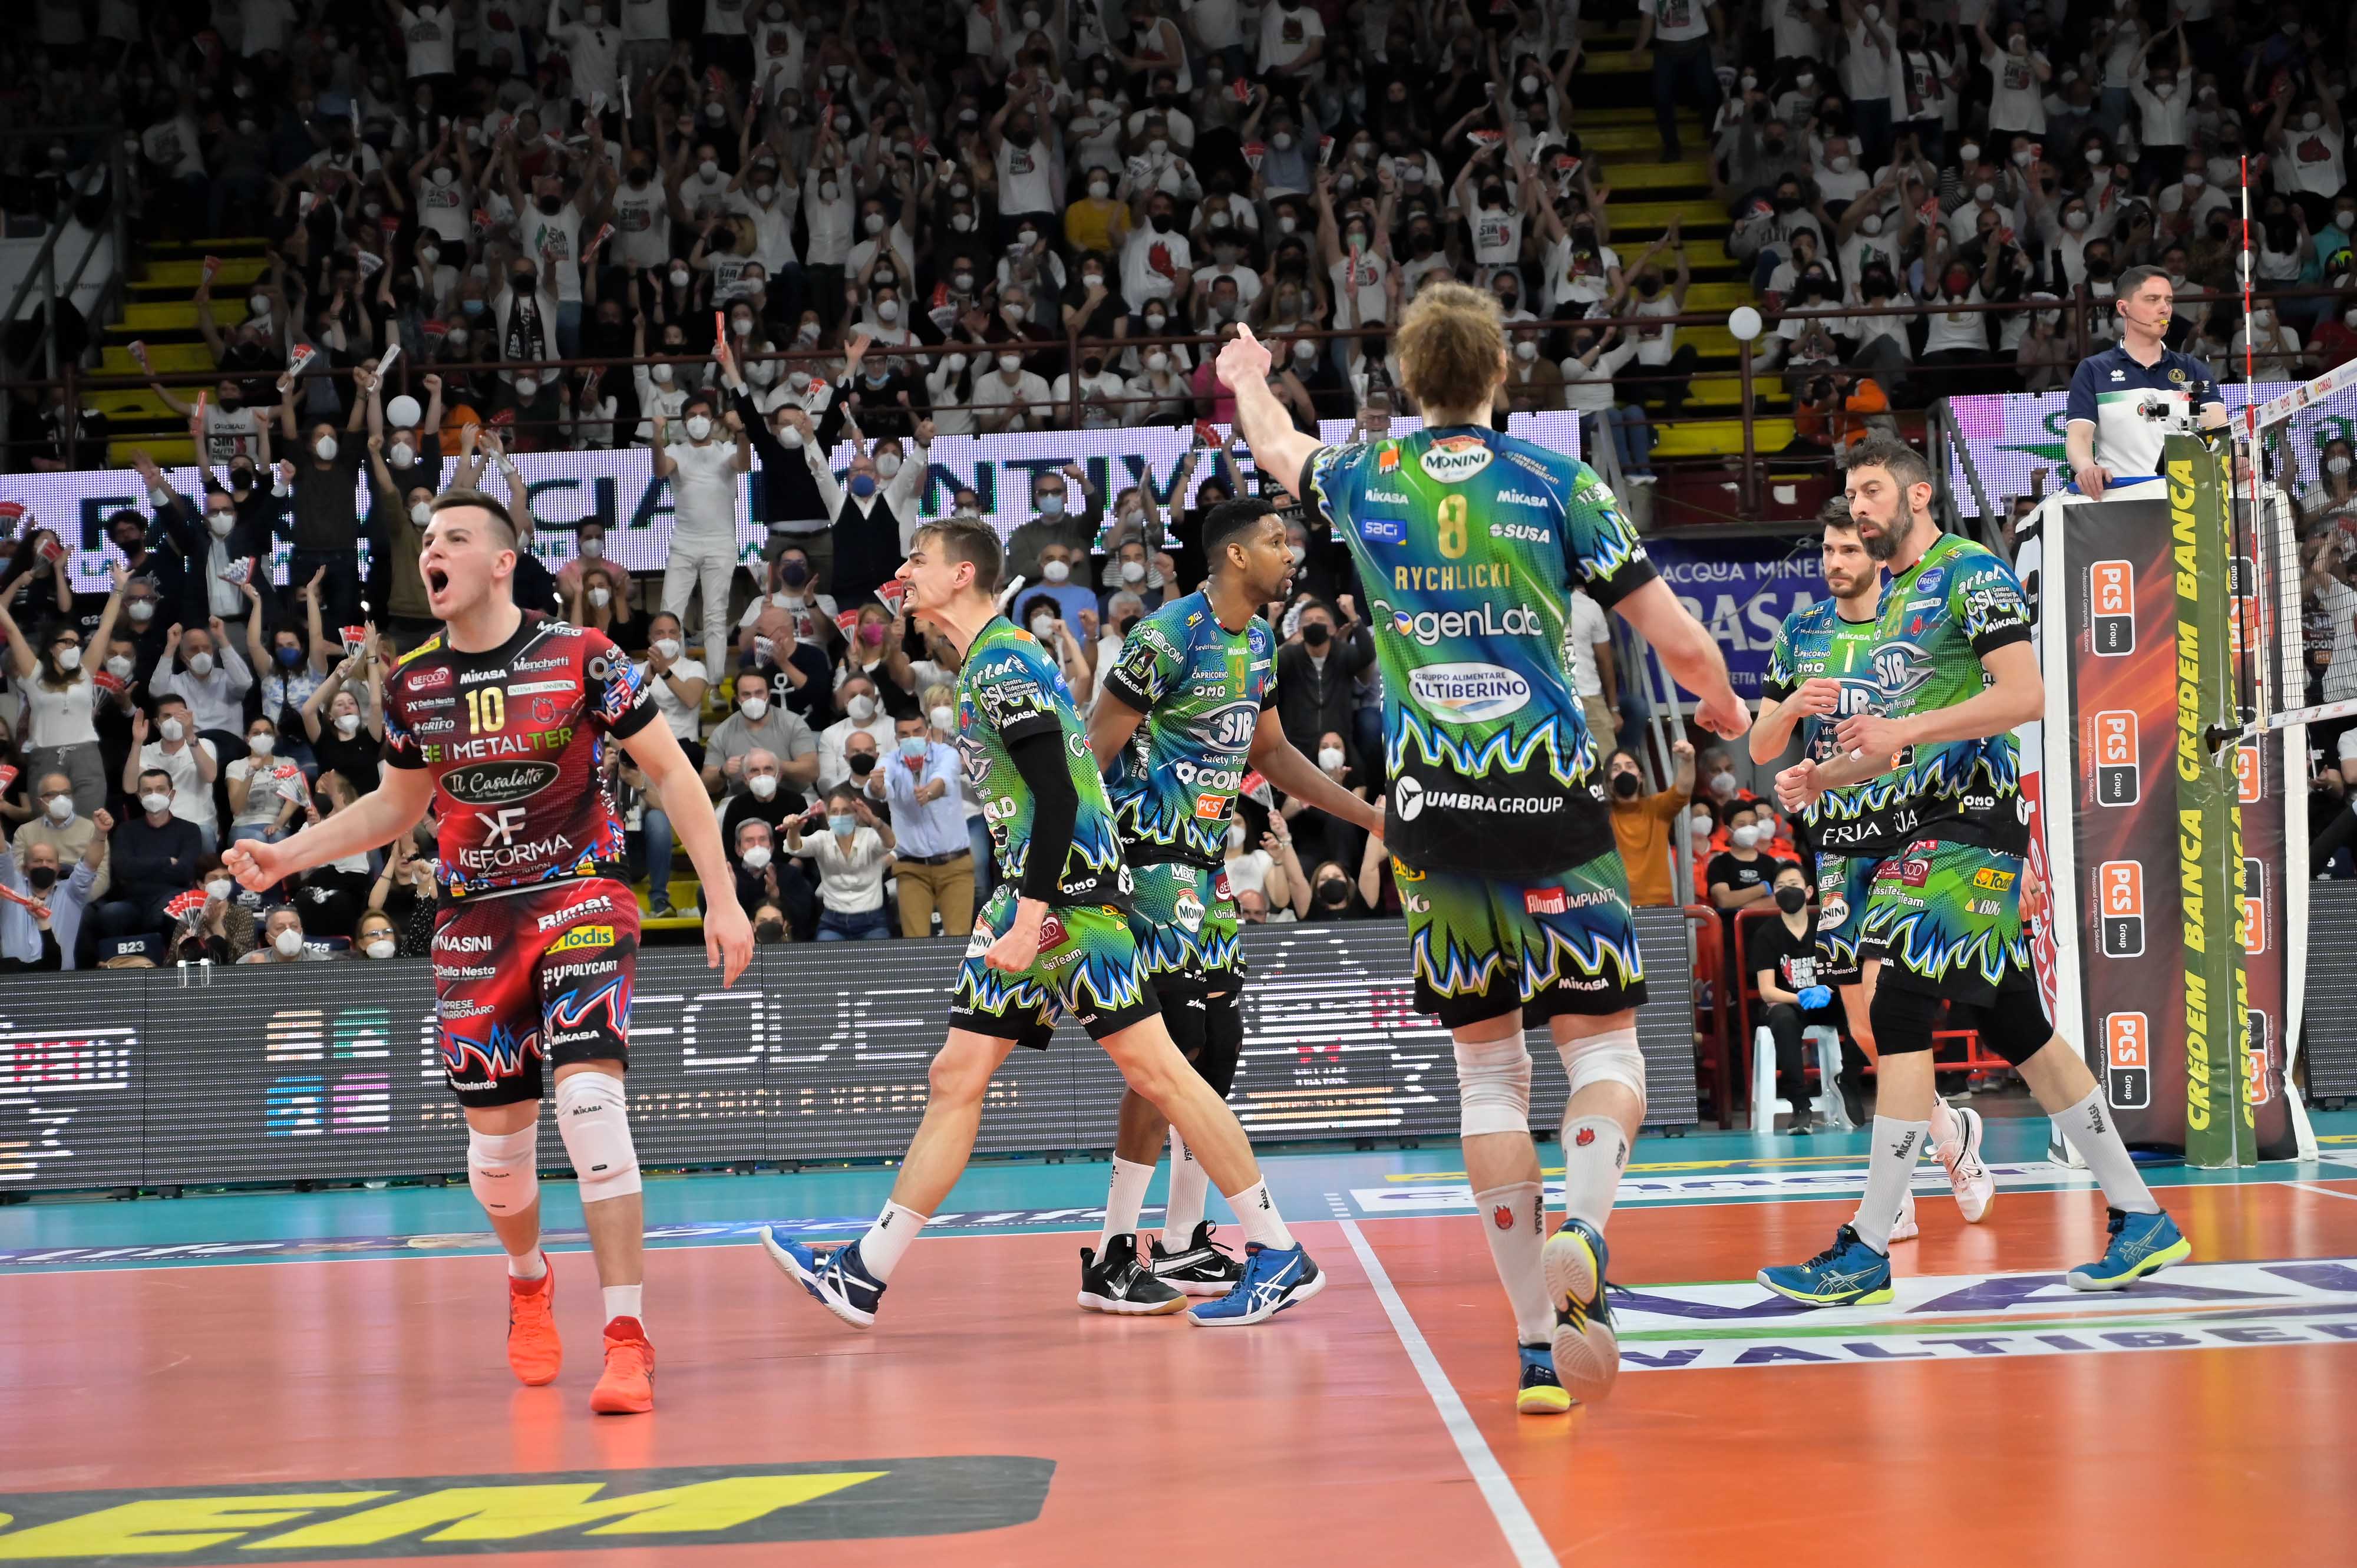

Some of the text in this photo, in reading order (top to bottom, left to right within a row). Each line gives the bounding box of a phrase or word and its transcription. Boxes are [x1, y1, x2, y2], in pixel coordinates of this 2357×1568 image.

[1426, 453, 1485, 470] MONINI
[1438, 494, 1467, 559] 8
[1503, 523, 1550, 544] SUSA
[2167, 460, 2198, 602] BANCA
[1395, 563, 1511, 590] RYCHLICKI
[1662, 557, 1825, 583] ACQUA MINE
[1965, 589, 1994, 616] CSI
[2101, 567, 2122, 648] PCS Group
[1193, 610, 1203, 620] GLS
[513, 656, 569, 671] Menchetti
[1161, 641, 1184, 665] COM
[1844, 641, 1855, 673] 1
[412, 671, 446, 685] BEFOOD
[1191, 671, 1229, 679] CAPRICORNO
[1235, 657, 1246, 693] 9
[1415, 671, 1506, 682] GRUPPO ALIMENTARE
[1797, 662, 1825, 673] OMG
[1875, 651, 1908, 687] SIR
[1002, 678, 1022, 687] Centro
[1005, 681, 1038, 694] Siderurgico
[1007, 687, 1039, 699] Industriale
[1193, 685, 1226, 698] OMG
[1415, 680, 1527, 699] ALTIBERINO
[418, 696, 456, 708] Della Nesta
[979, 683, 1006, 712] CSI
[1893, 697, 1916, 711] Perugia
[2177, 620, 2200, 783] CREDEM
[465, 686, 505, 734] 10
[421, 719, 455, 731] GRIFO
[453, 727, 573, 760] METALTER
[1201, 754, 1247, 767] Safety Peru
[2107, 718, 2127, 798] PCS Group
[470, 767, 544, 793] Casaletto
[1196, 768, 1242, 791] CON
[1199, 799, 1221, 813] PCS
[1963, 795, 1995, 807] OMG
[458, 834, 573, 871] KEFORMA
[1062, 877, 1098, 895] OMG
[1219, 880, 1232, 893] BEF
[2180, 809, 2206, 953] BANCA
[537, 895, 612, 926] Rimat
[1526, 888, 1616, 914] Alunni IMPIANTI
[2111, 868, 2132, 949] PCS Group
[438, 935, 493, 952] NASINI
[565, 927, 611, 947] Todis
[117, 942, 144, 954] B23
[438, 966, 496, 976] Della Nesta
[565, 960, 618, 976] POLYCART
[2117, 1019, 2137, 1100] PCS Group
[2184, 969, 2210, 1131] CREDEM
[0, 1471, 891, 1560] EM
